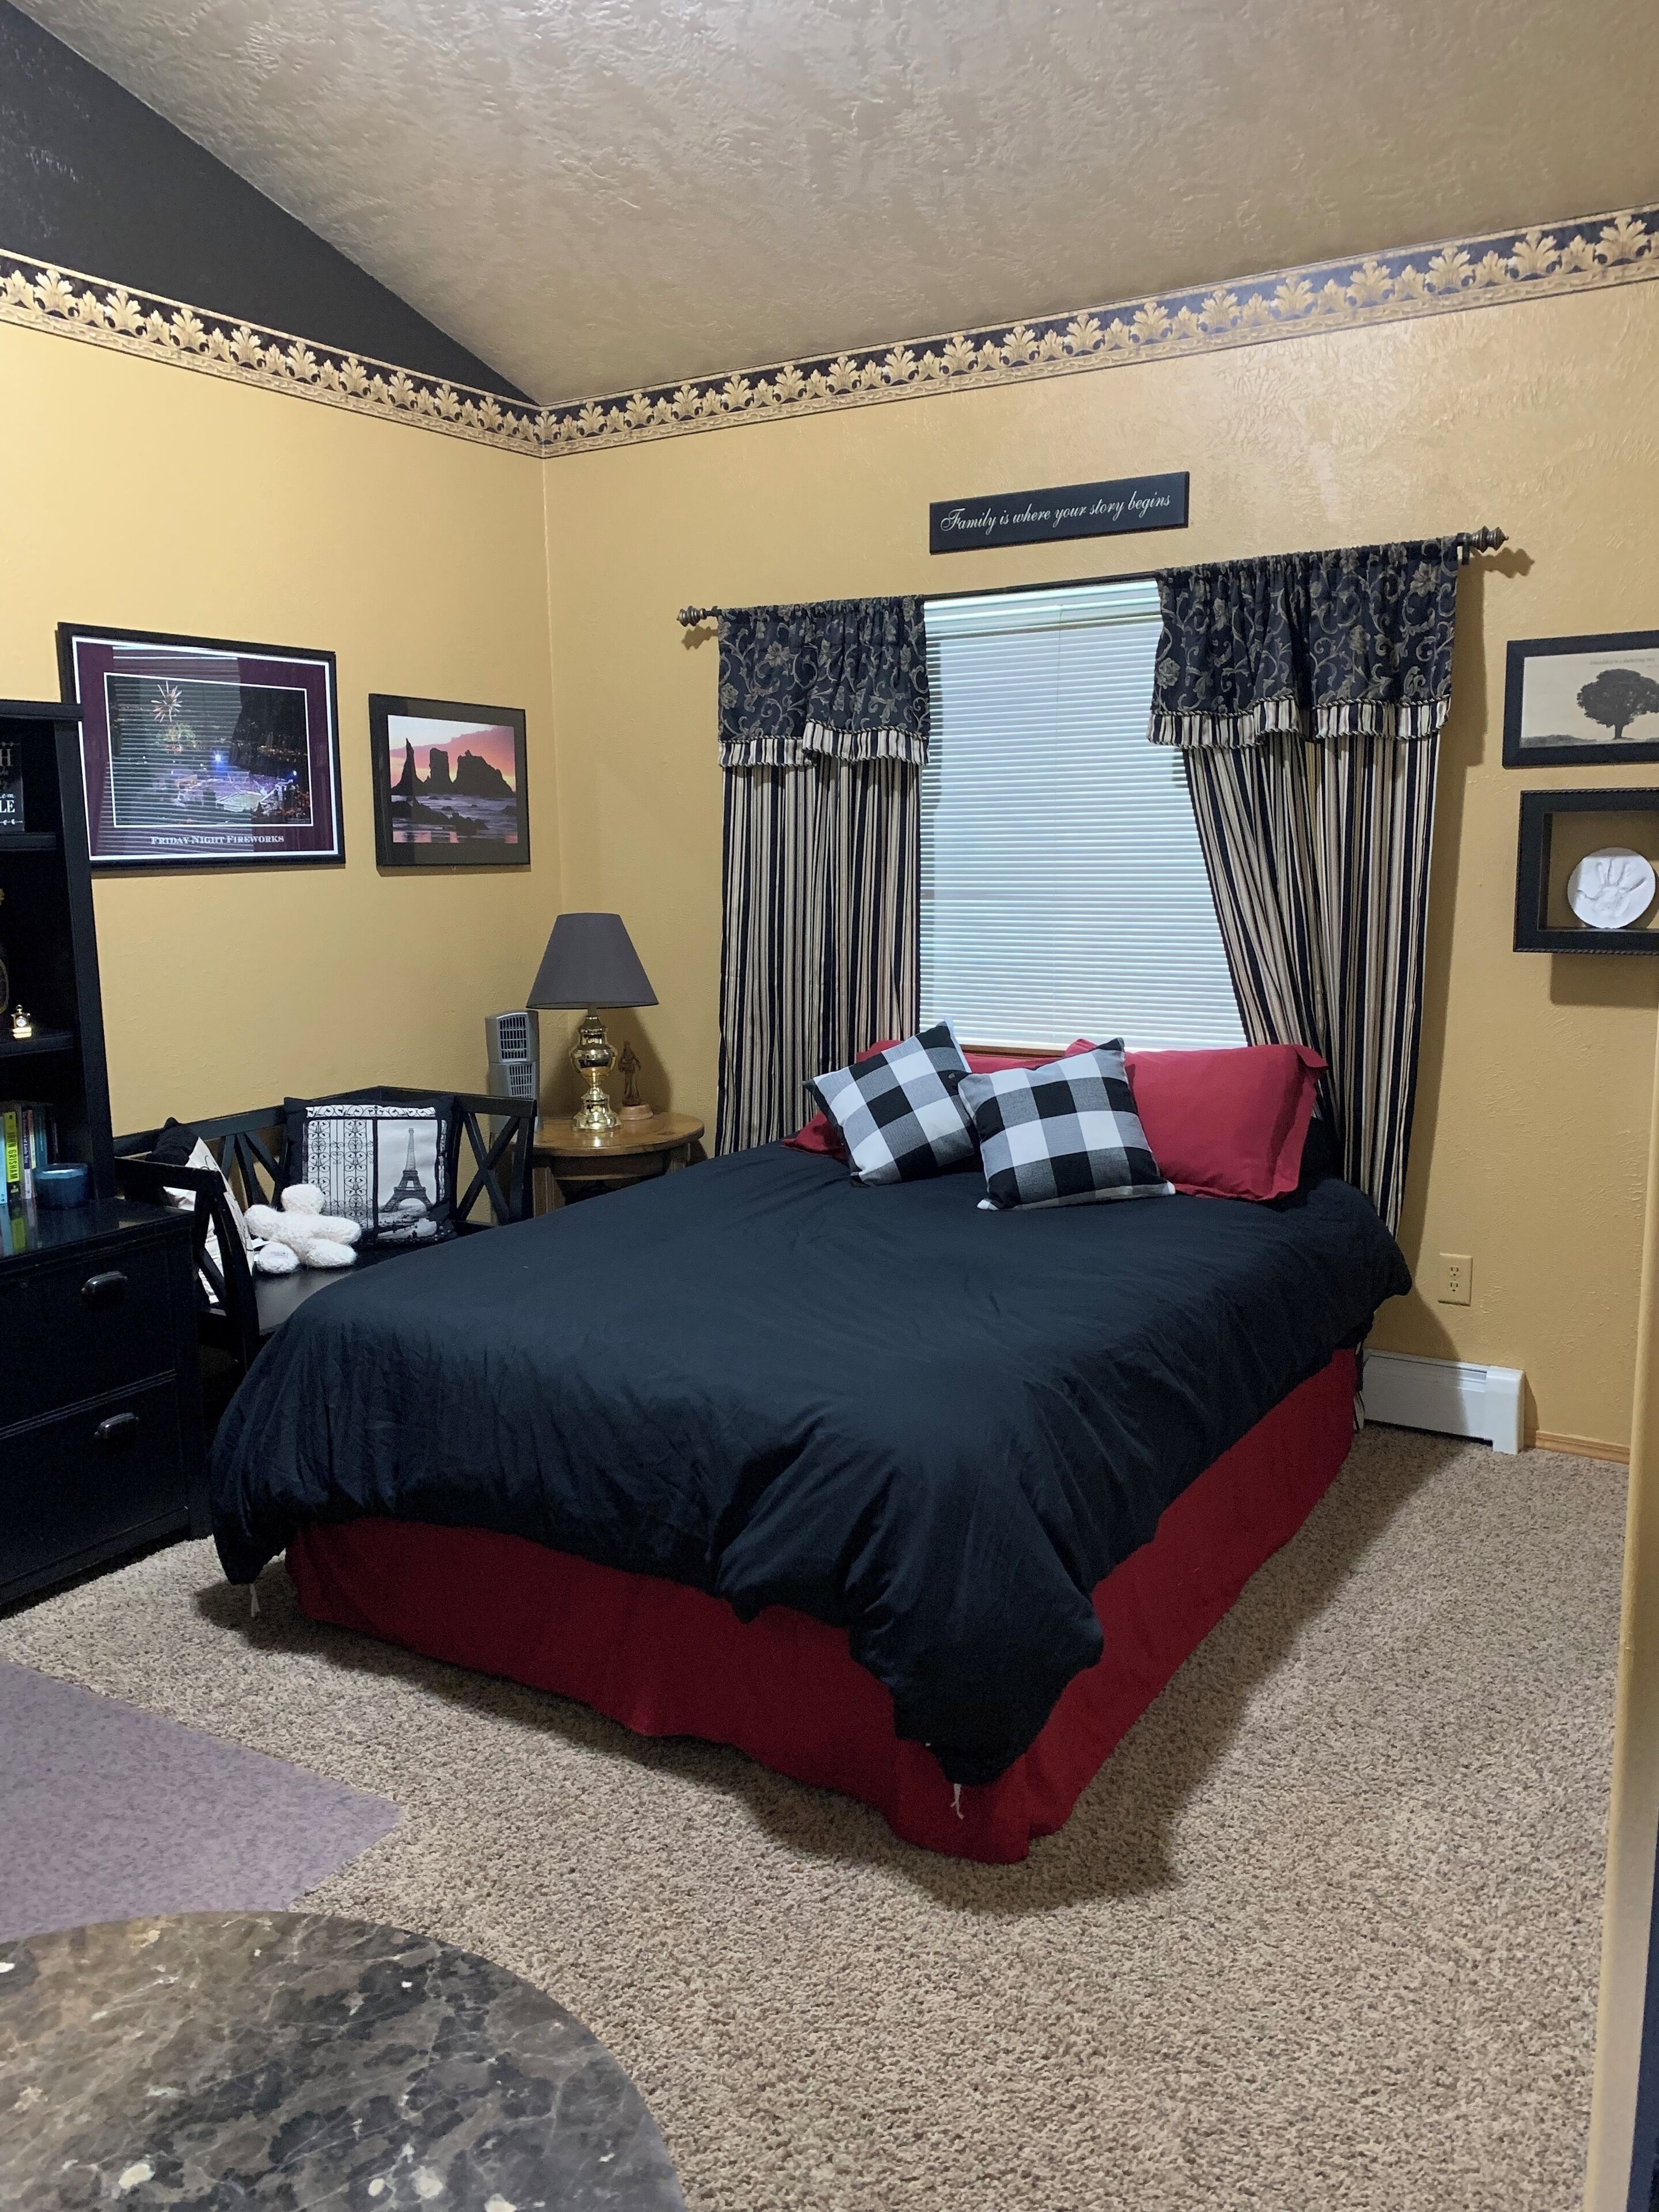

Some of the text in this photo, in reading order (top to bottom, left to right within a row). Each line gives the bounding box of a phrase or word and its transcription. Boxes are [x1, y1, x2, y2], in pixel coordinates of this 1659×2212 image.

[940, 490, 1171, 535] Family is where your story begins
[150, 835, 285, 844] FRIDAY NIGHT FIREWORKS
[7, 1132, 18, 1180] JOHN GRISHAM
